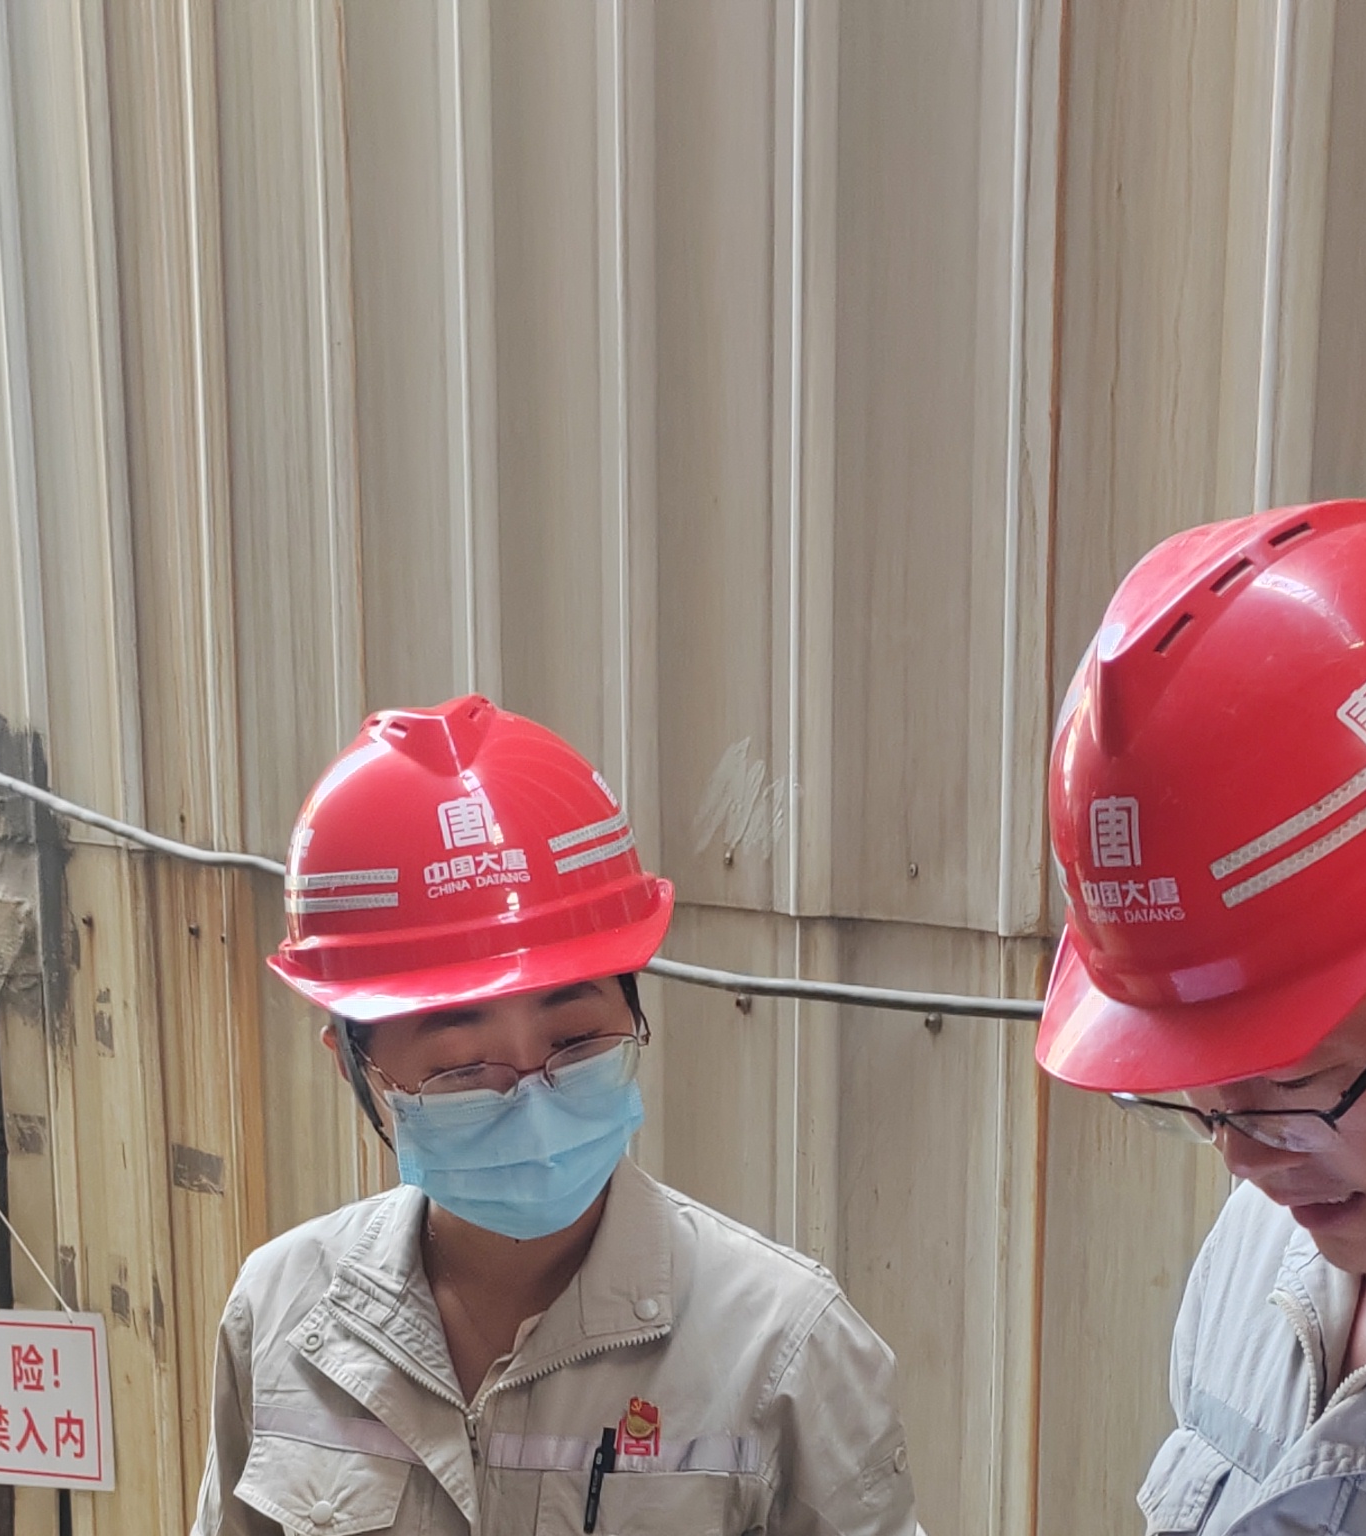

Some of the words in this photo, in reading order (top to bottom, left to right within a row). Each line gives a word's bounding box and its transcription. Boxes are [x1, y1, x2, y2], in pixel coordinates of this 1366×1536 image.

[423, 848, 529, 884] 中国大唐
[427, 879, 471, 899] CHINA
[475, 870, 531, 888] DATANG
